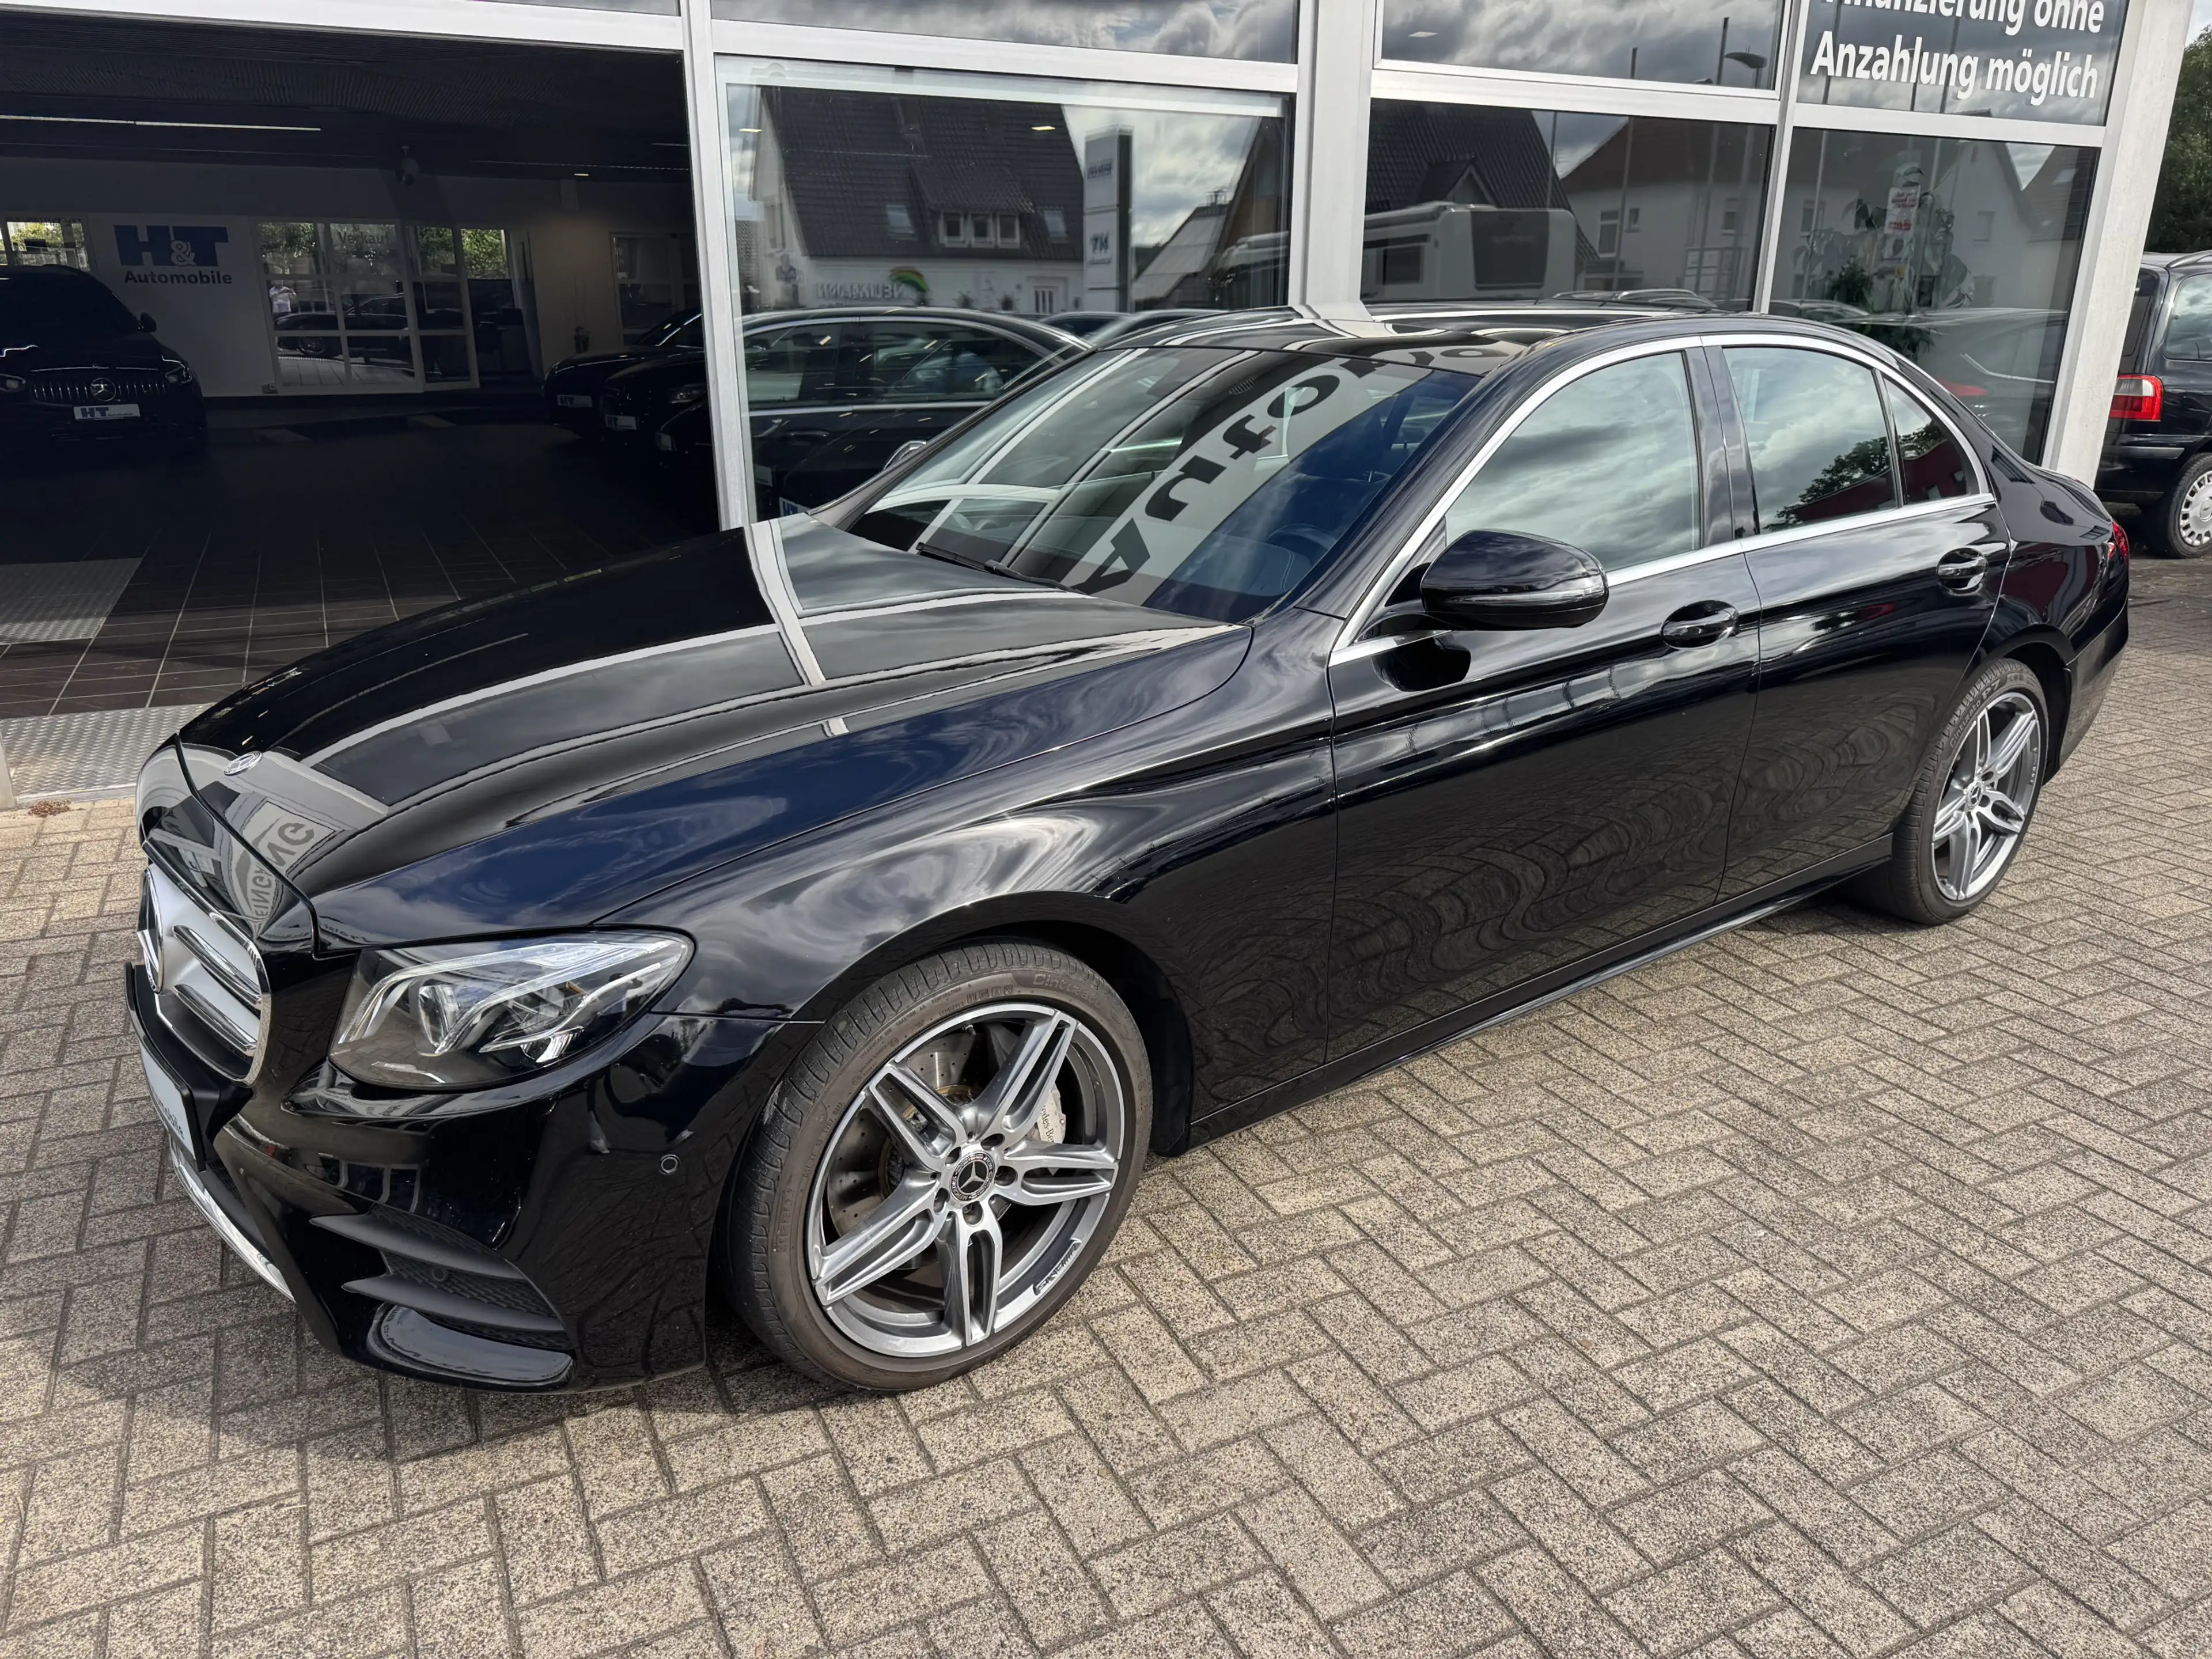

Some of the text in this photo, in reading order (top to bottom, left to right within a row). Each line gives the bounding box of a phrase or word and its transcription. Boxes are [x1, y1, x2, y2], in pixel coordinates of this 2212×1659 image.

[2033, 0, 2104, 33] ohne
[1810, 31, 2099, 106] Anzahlung möglich
[113, 225, 229, 267] H&T
[124, 270, 232, 284] Automobile
[1950, 679, 2001, 748] Cinturato P7
